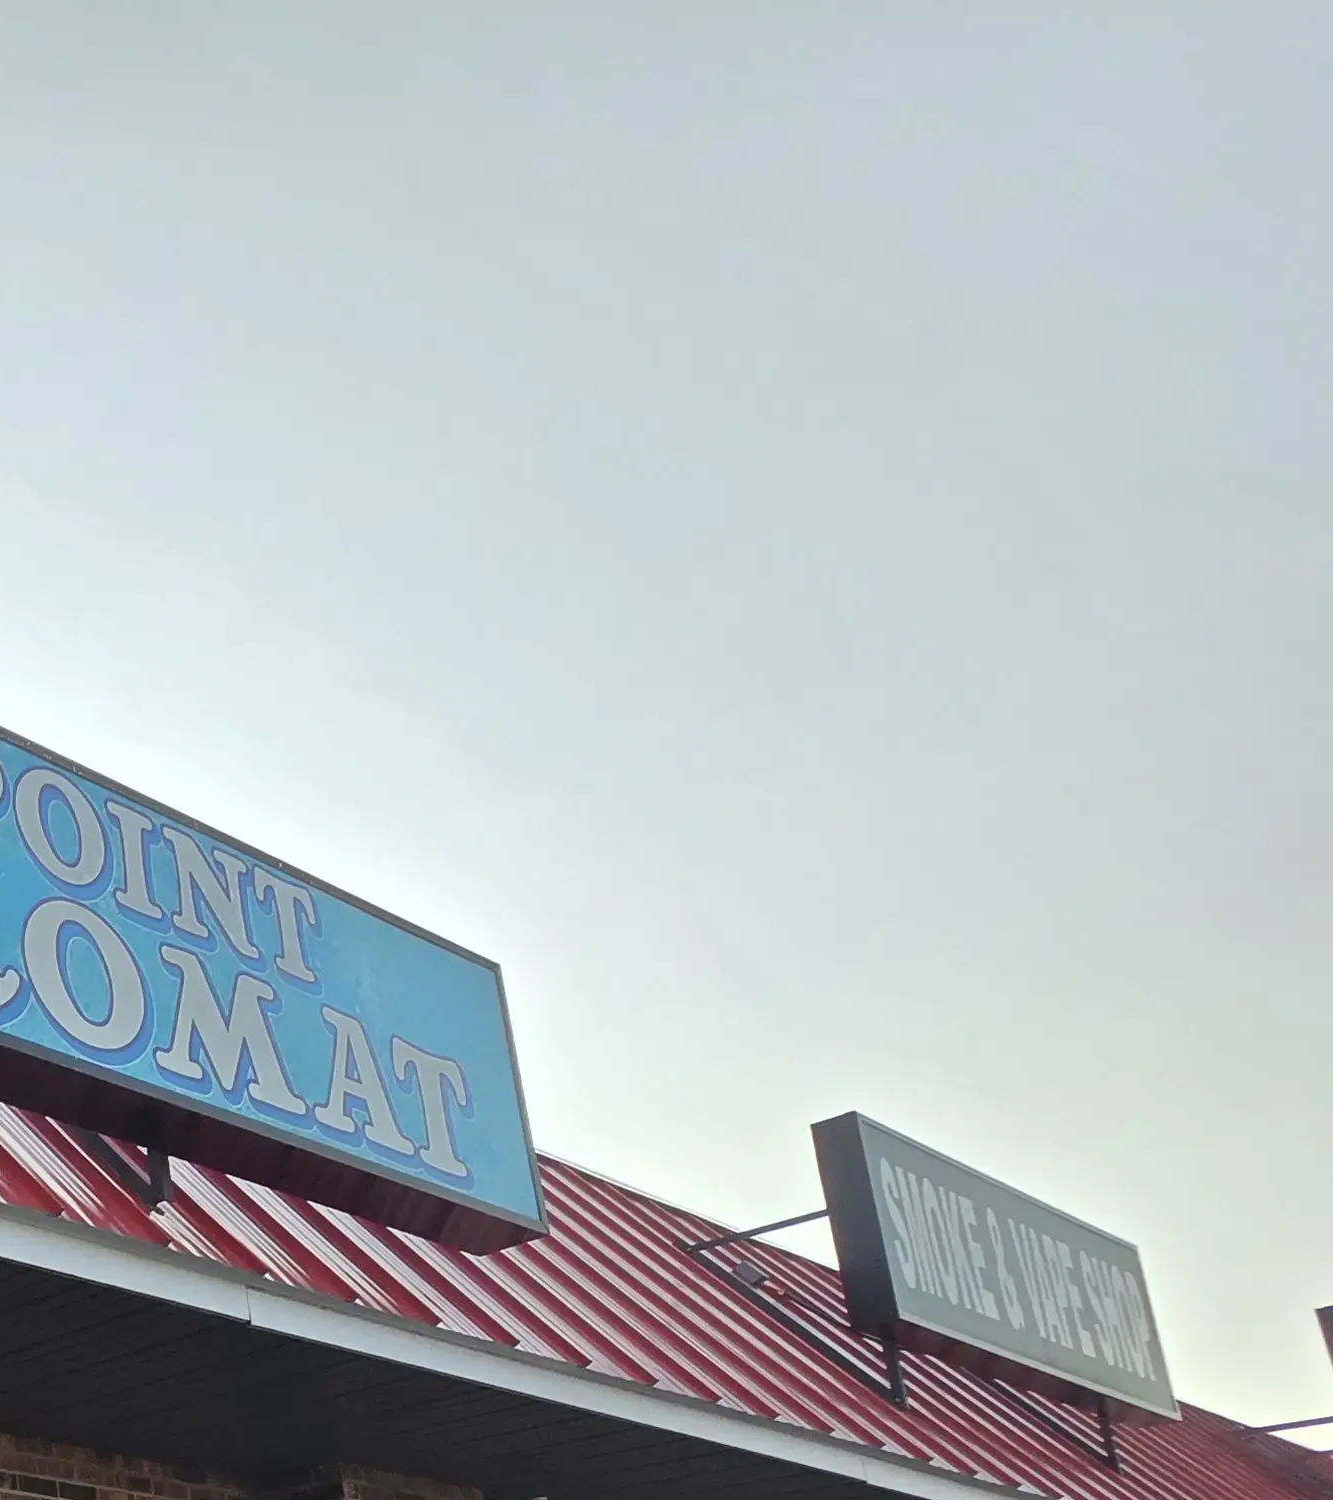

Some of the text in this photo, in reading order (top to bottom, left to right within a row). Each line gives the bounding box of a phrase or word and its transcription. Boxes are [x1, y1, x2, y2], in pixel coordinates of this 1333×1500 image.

[880, 1157, 1156, 1381] SMOKE & VAPE SHOP
